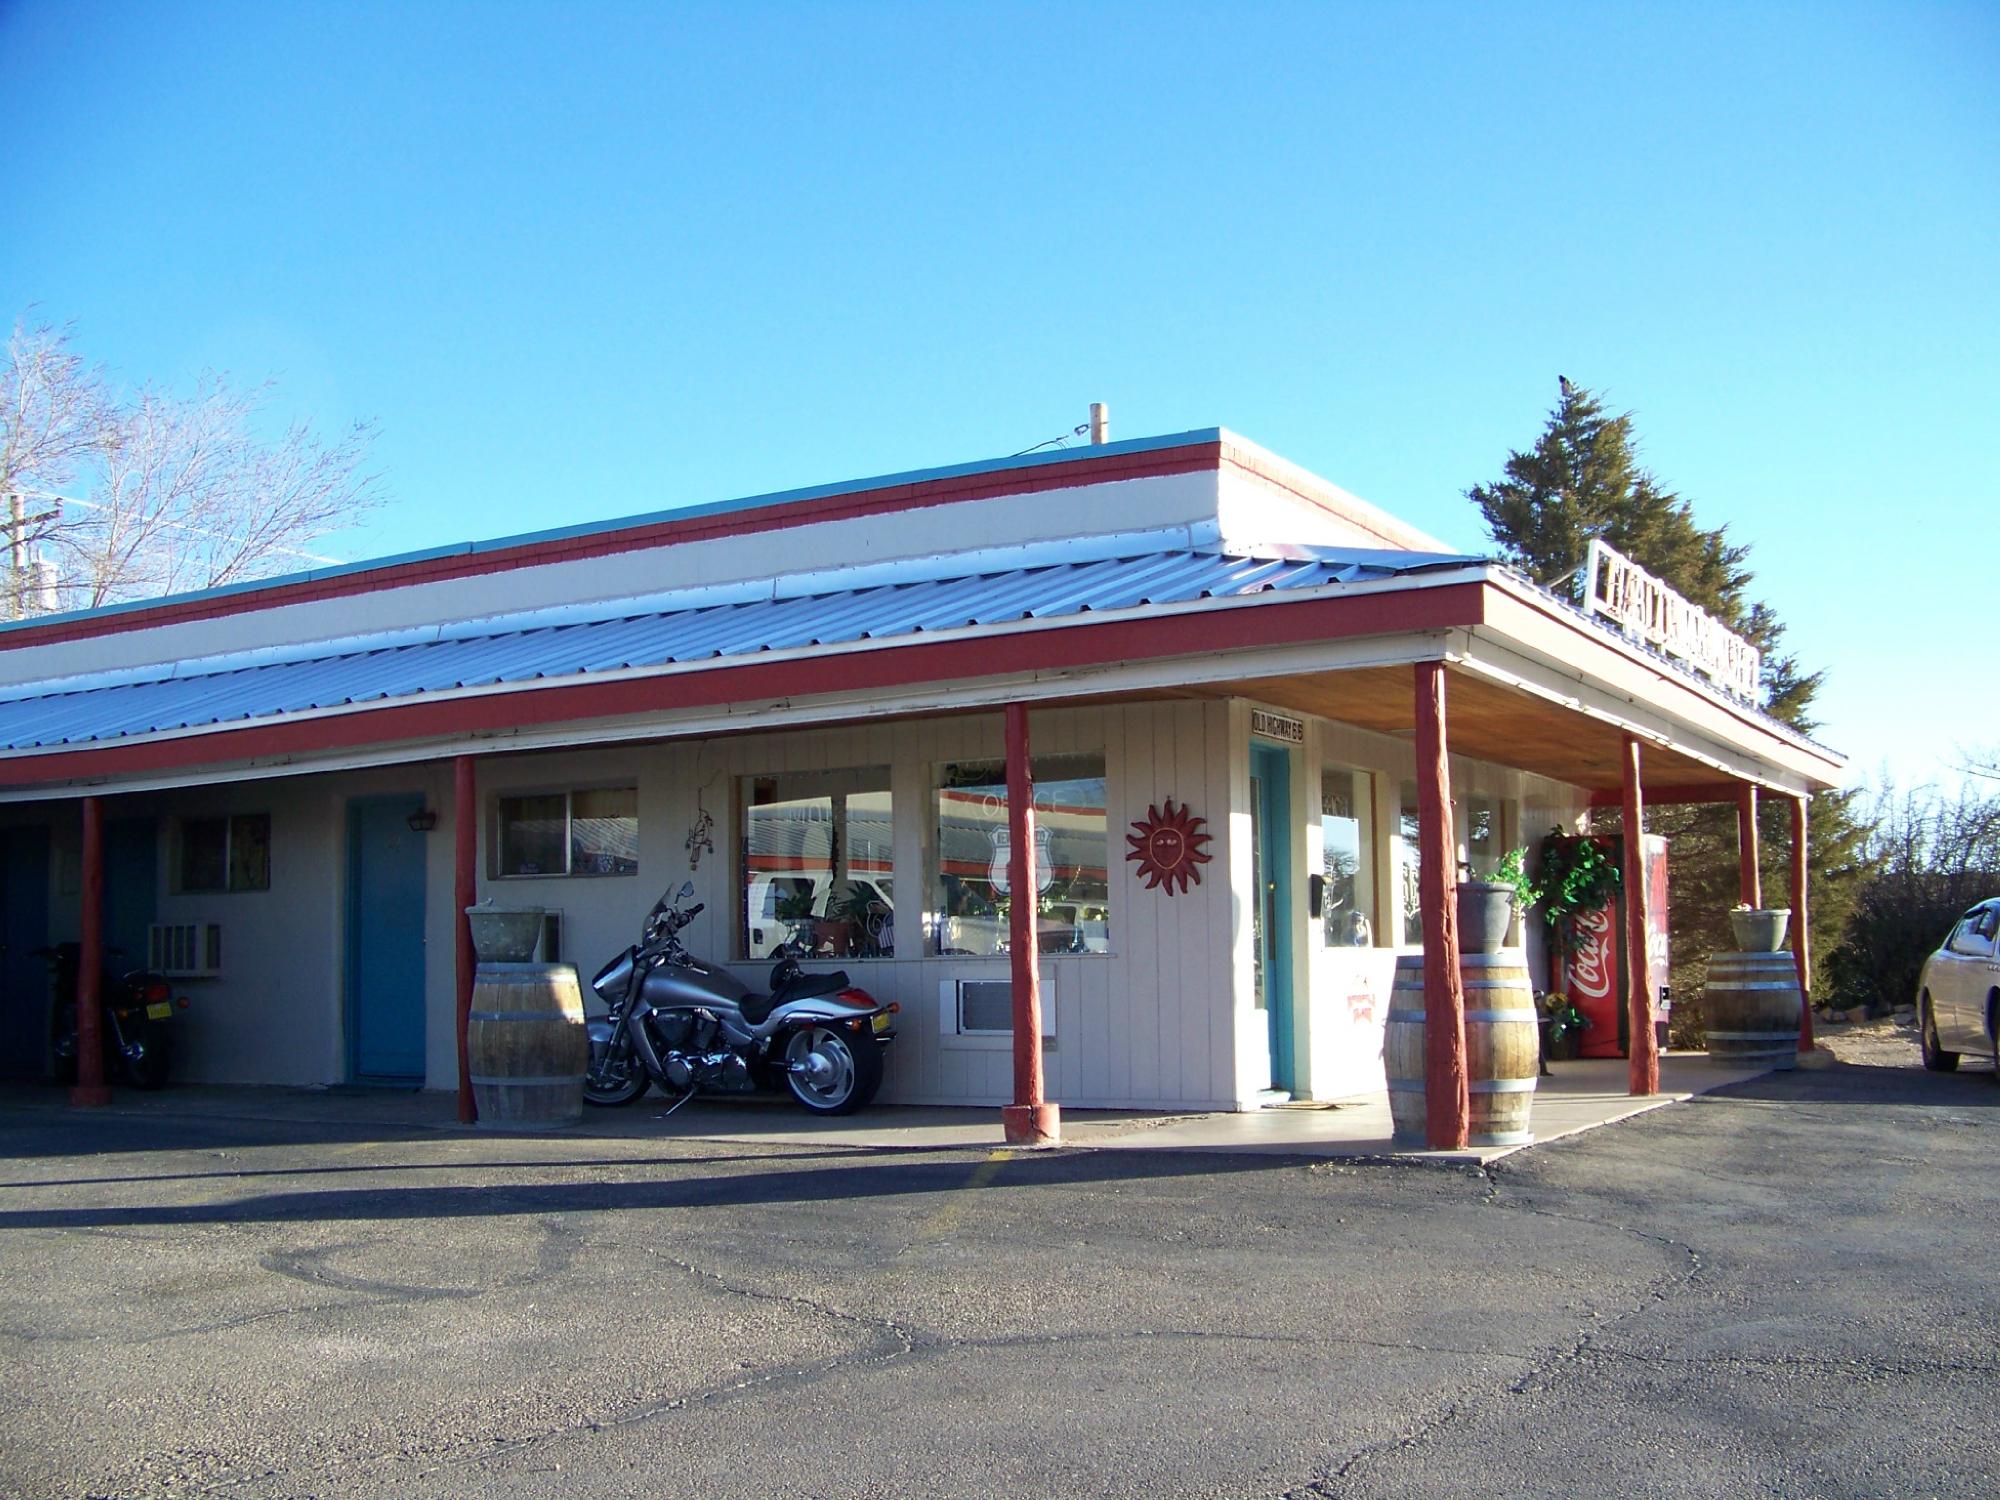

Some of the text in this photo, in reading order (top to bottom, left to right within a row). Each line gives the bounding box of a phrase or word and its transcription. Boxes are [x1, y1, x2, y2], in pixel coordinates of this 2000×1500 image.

[1253, 711, 1303, 741] OLD HIGHWAY 66
[982, 789, 1067, 818] OFCE
